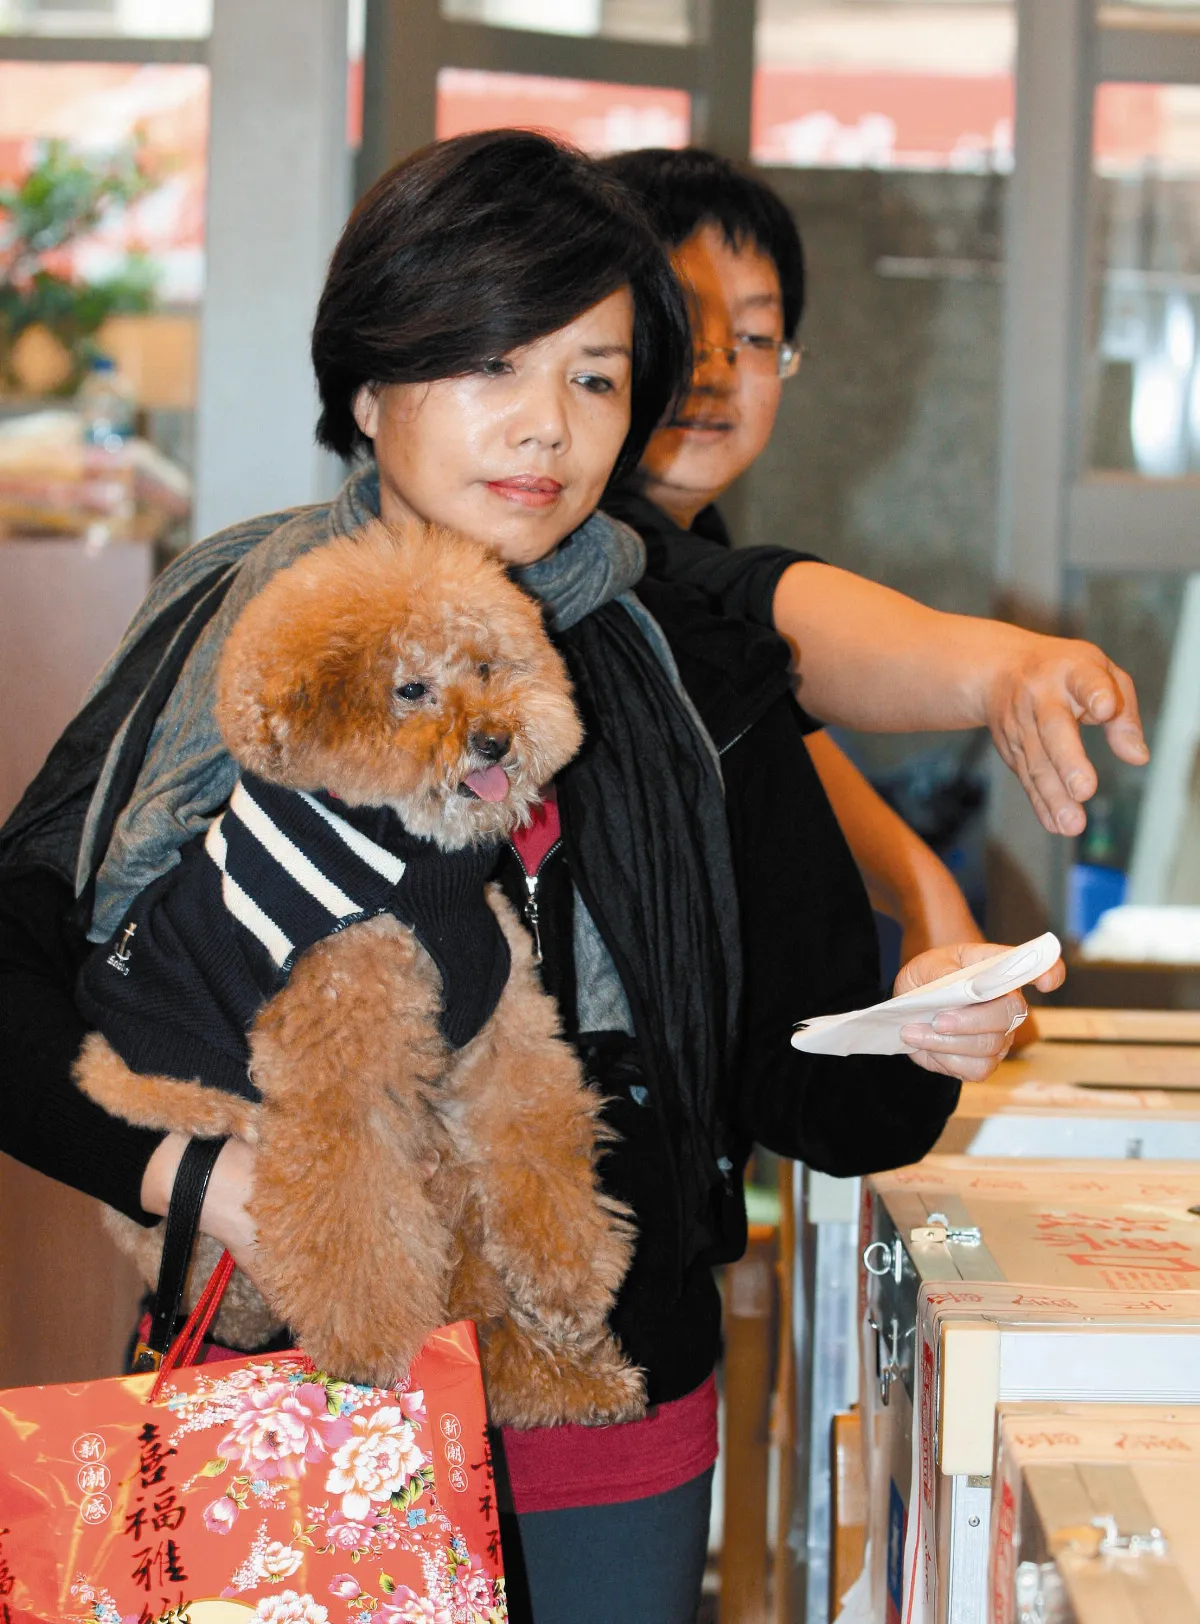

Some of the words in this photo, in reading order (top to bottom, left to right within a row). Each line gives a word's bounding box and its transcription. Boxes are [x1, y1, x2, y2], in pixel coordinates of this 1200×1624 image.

[76, 1435, 109, 1521] 新潮感
[442, 1416, 466, 1490] 新潮感
